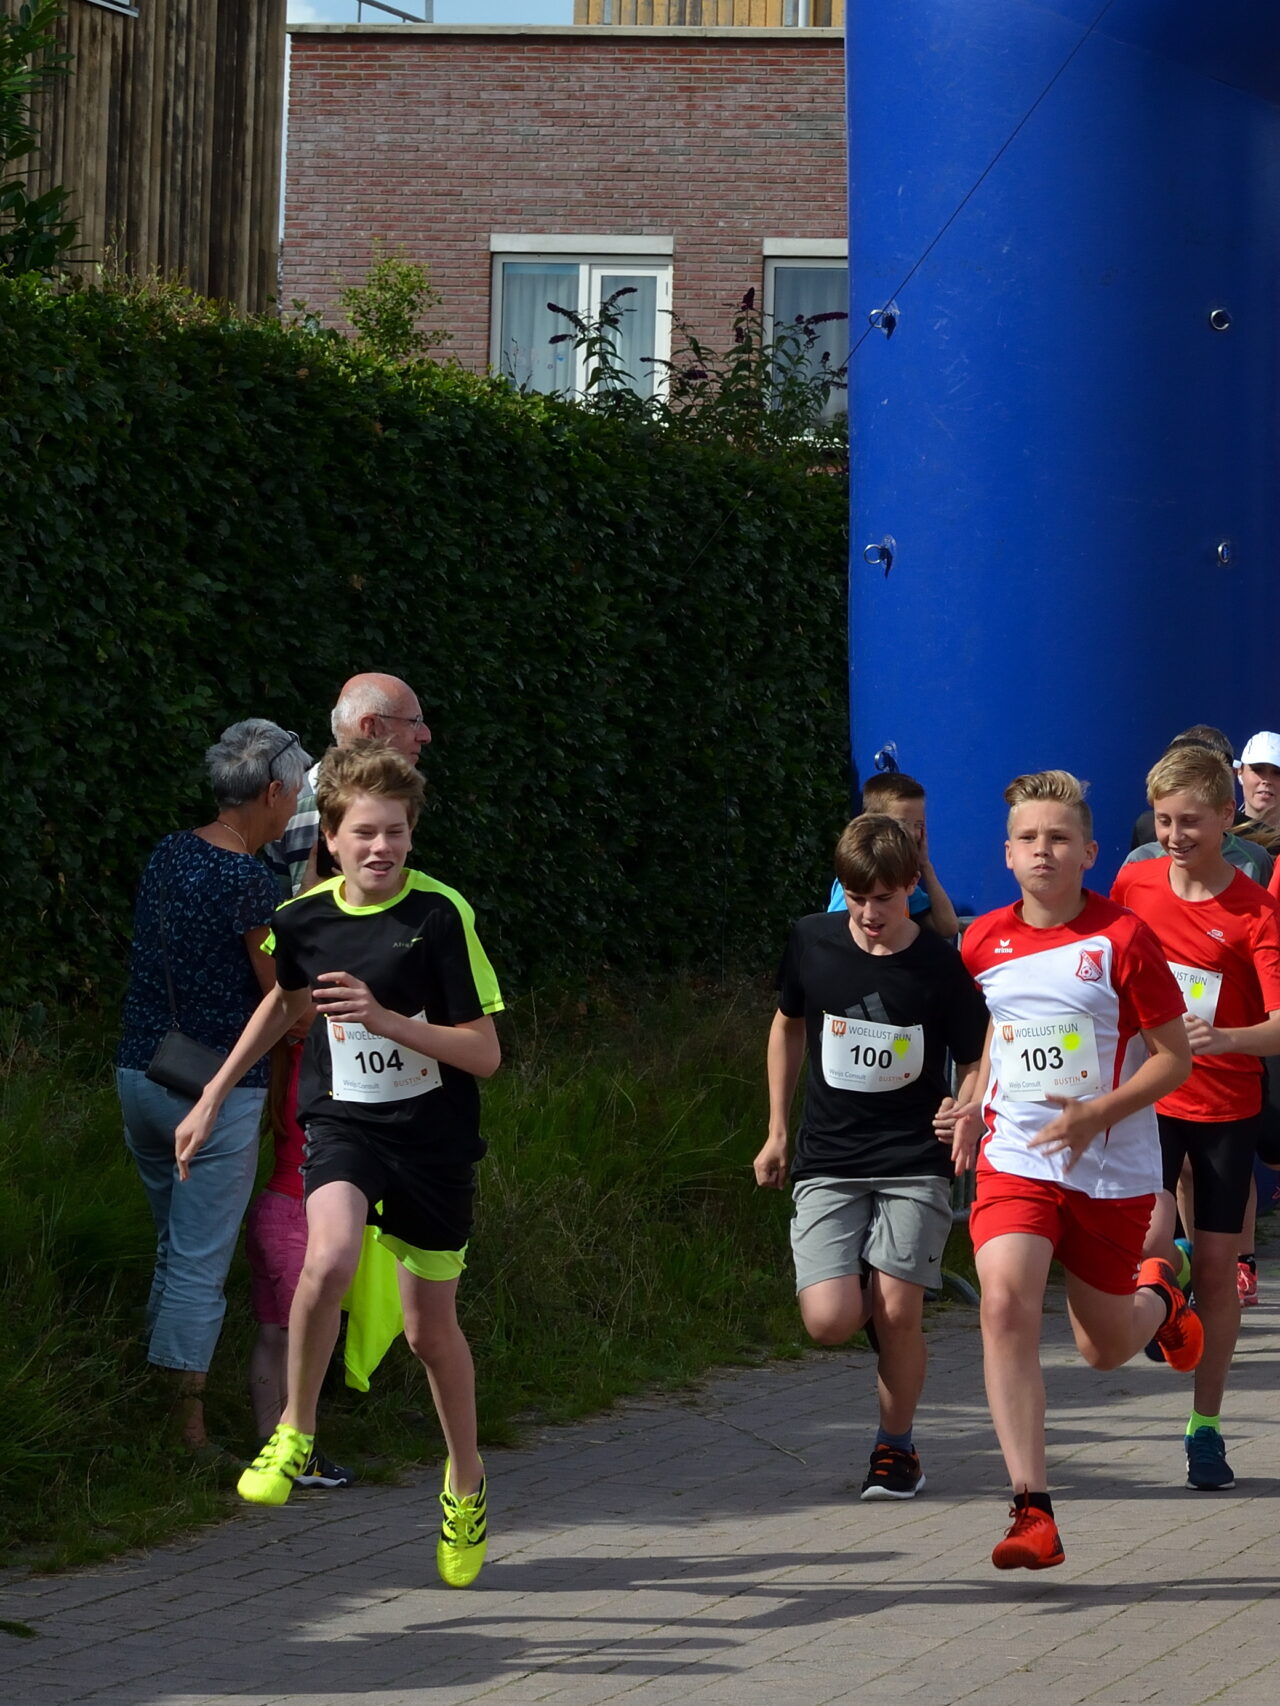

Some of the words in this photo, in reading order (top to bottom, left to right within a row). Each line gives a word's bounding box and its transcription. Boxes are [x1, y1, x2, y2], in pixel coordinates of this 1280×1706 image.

[1190, 974, 1208, 986] RUN
[848, 1025, 892, 1041] WOELLUST
[893, 1032, 912, 1042] RUN
[1015, 1025, 1057, 1038] WOELLUST
[1058, 1023, 1079, 1033] RUN
[355, 1050, 404, 1075] 104
[850, 1044, 893, 1069] 100
[1020, 1046, 1064, 1072] 103
[393, 1076, 422, 1087] BUSTIN
[1054, 1077, 1081, 1086] BUSTIN
